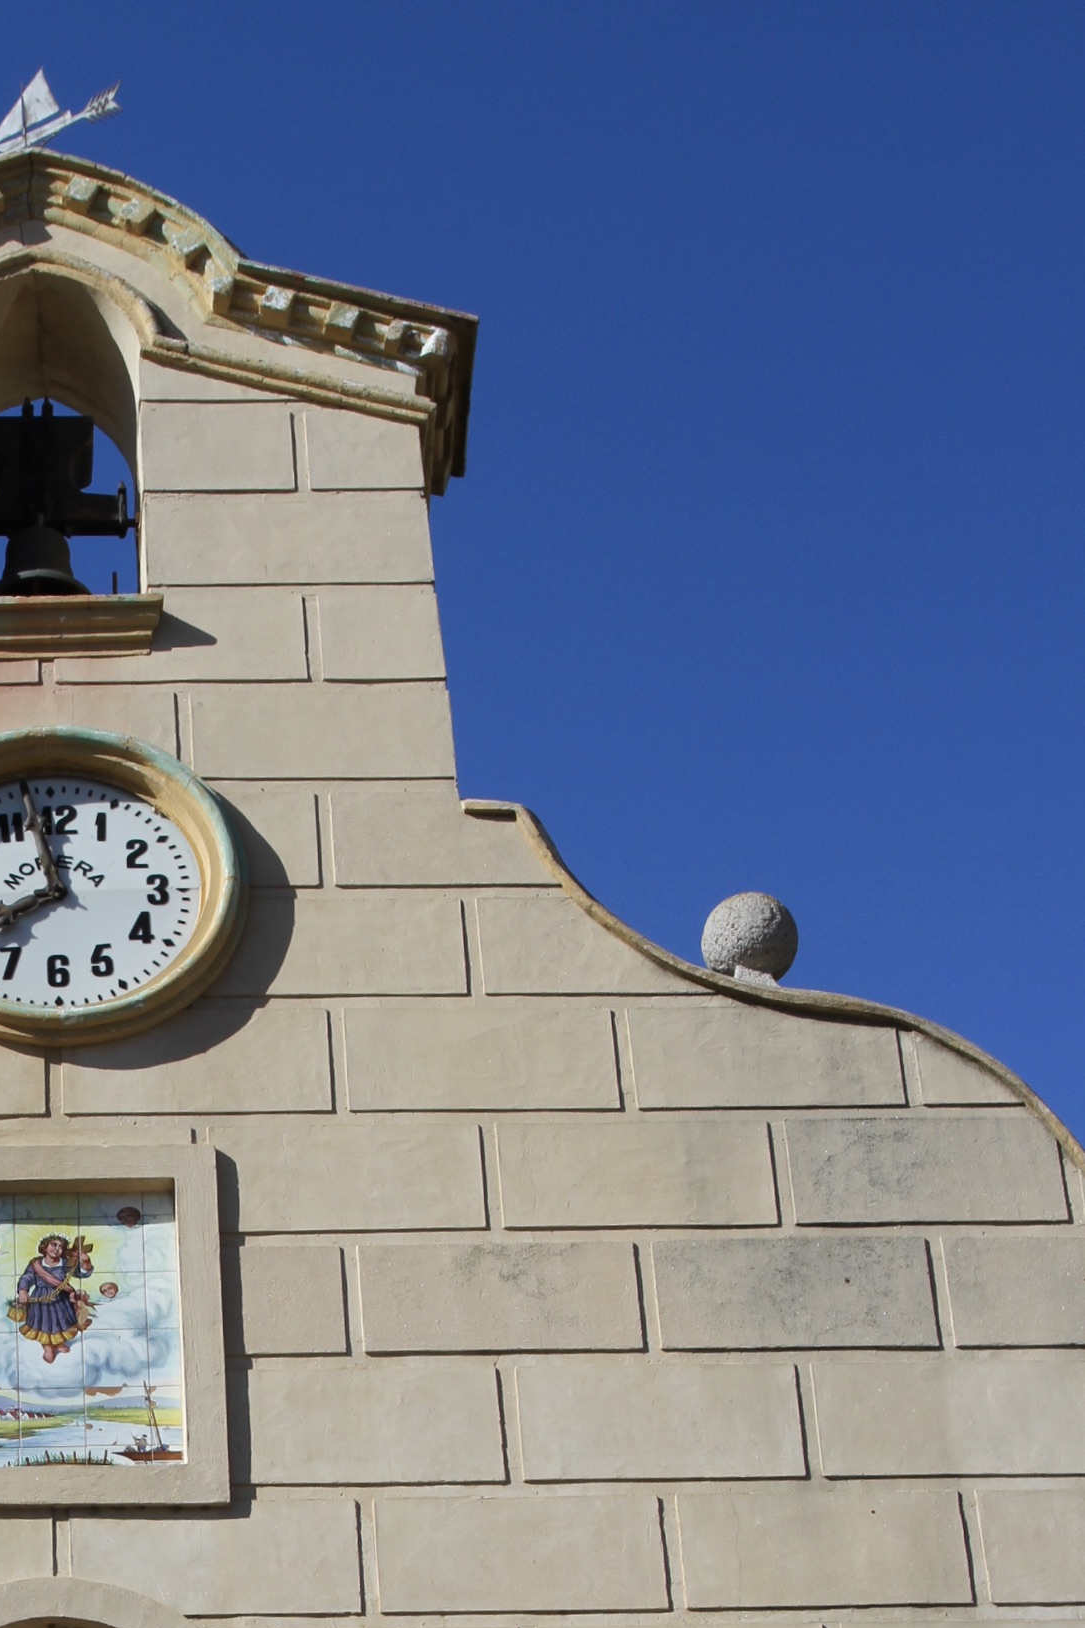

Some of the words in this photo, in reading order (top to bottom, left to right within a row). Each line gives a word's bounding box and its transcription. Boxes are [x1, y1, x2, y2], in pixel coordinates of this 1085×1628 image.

[41, 804, 79, 836] 12
[95, 812, 107, 842] 1
[126, 839, 149, 869] 2
[146, 874, 170, 906] 3
[128, 911, 155, 944] 4
[0, 946, 22, 981] 7
[47, 954, 70, 988] 6
[90, 943, 114, 977] 5
